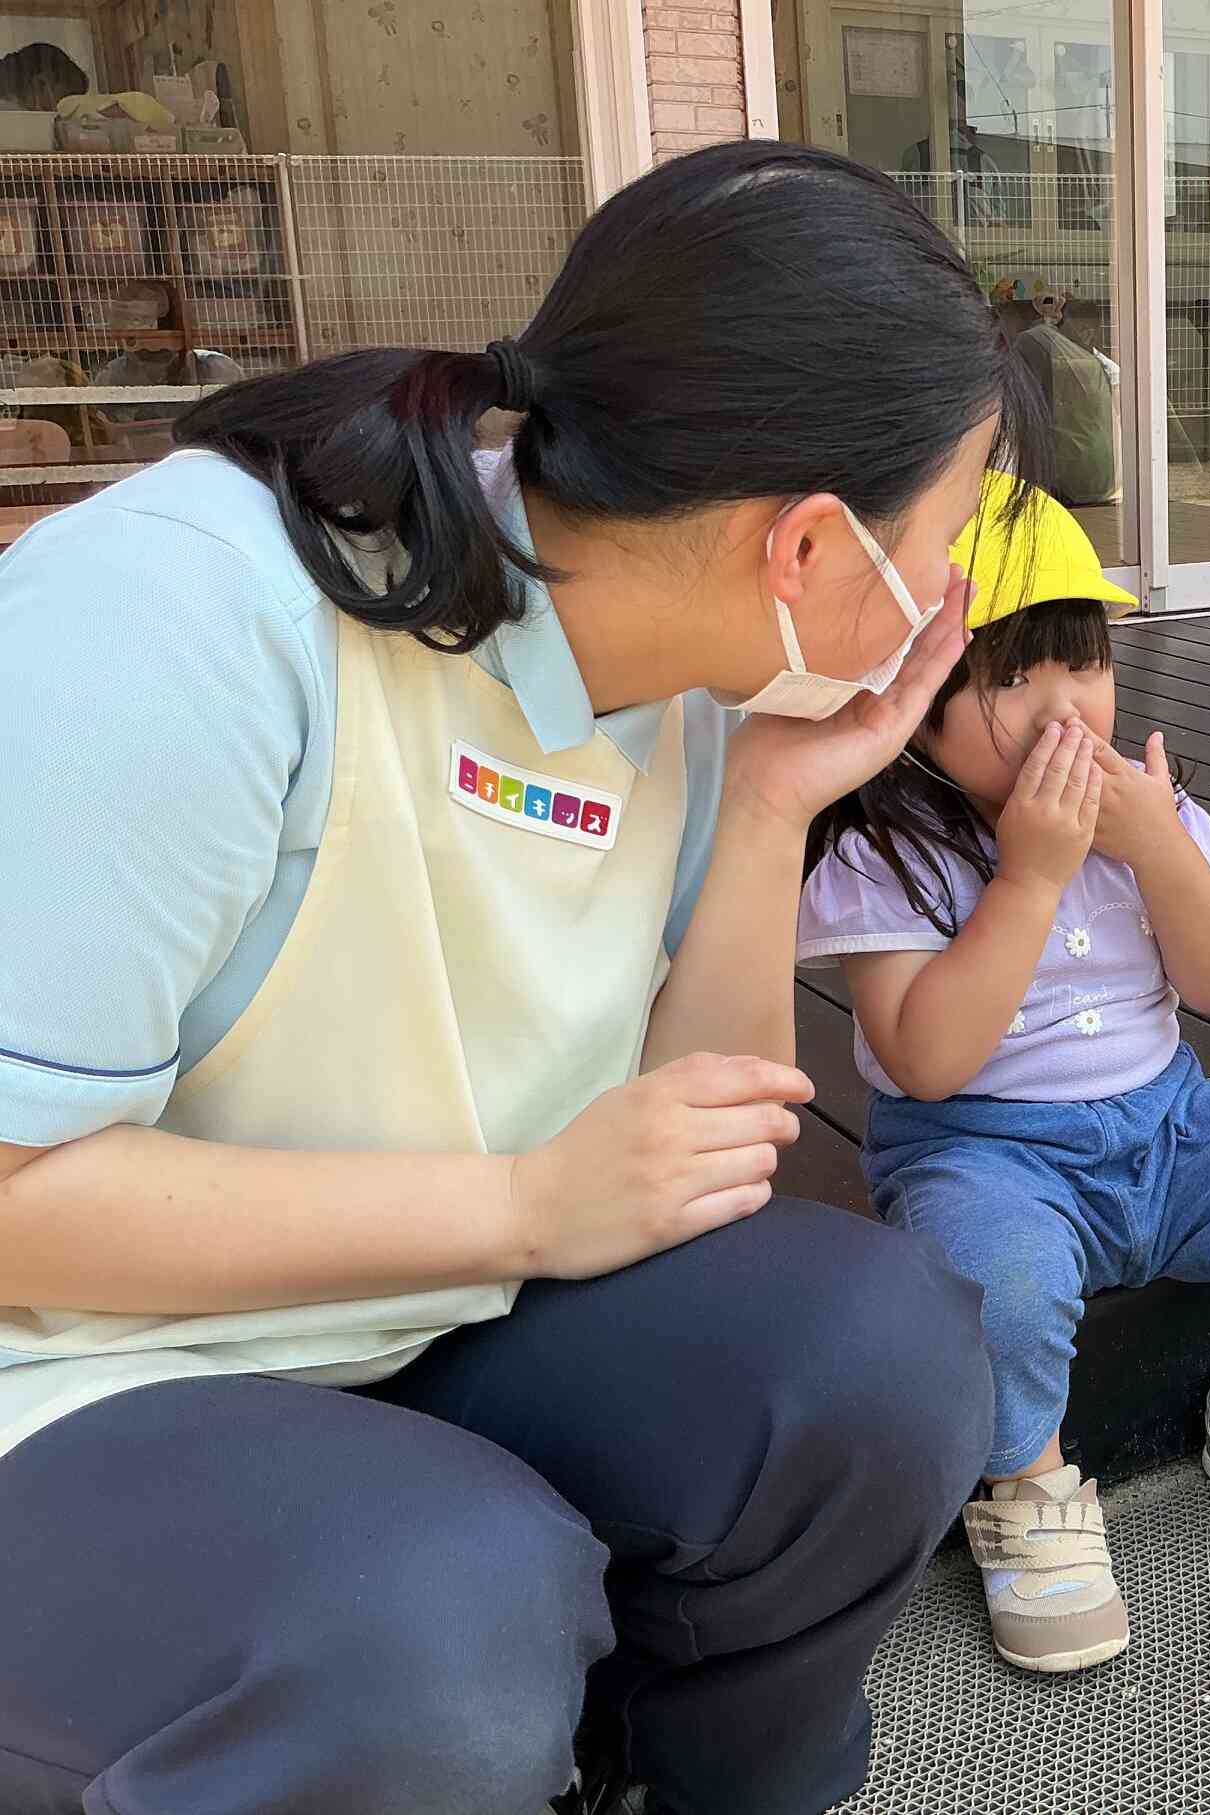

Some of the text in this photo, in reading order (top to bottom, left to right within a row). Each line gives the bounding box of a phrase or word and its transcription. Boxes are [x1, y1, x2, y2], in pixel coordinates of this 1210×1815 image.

[463, 770, 608, 833] ニチイキッズ
